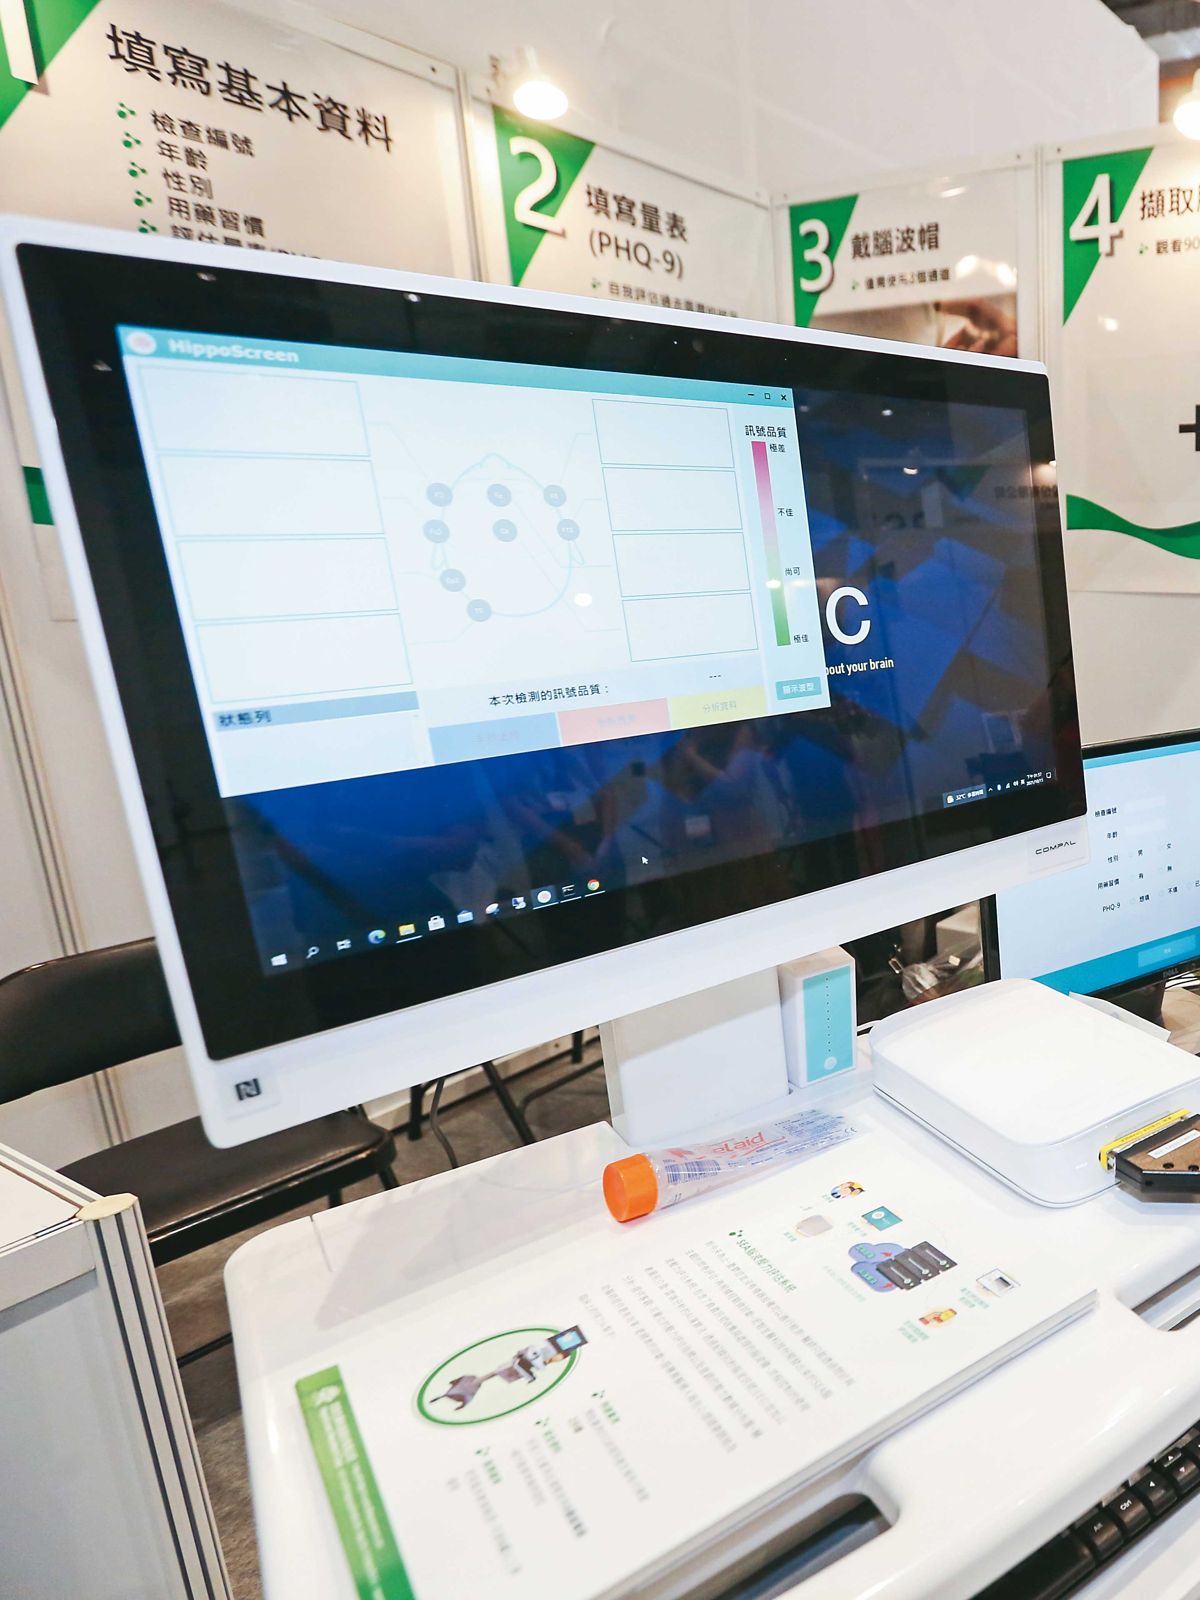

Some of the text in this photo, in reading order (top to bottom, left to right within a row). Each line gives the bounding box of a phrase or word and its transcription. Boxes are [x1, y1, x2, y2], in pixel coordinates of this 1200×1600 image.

[106, 23, 393, 153] 填寫基本資料
[151, 110, 255, 157] 檢查編號
[158, 140, 208, 172] 年齡
[163, 168, 214, 200] 性別
[509, 136, 565, 236] 2
[168, 196, 266, 238] 用藥習慣
[586, 184, 688, 242] 填寫量表
[1070, 173, 1120, 255] 4
[589, 228, 683, 279] (PHQ-9)
[800, 219, 833, 292] 3
[852, 222, 939, 259] 戴腦波帽
[168, 338, 299, 363] HippoScreen
[745, 425, 787, 438] 訊號品質
[769, 443, 786, 453] 極差
[777, 507, 794, 517] 不佳
[826, 586, 871, 645] C
[847, 661, 868, 676] your
[869, 657, 894, 670] brain
[219, 710, 272, 727] 狀態列
[1035, 841, 1077, 855] COMPAL
[1102, 902, 1121, 912] PHQ-9
[1120, 1499, 1132, 1511] Ctrl
